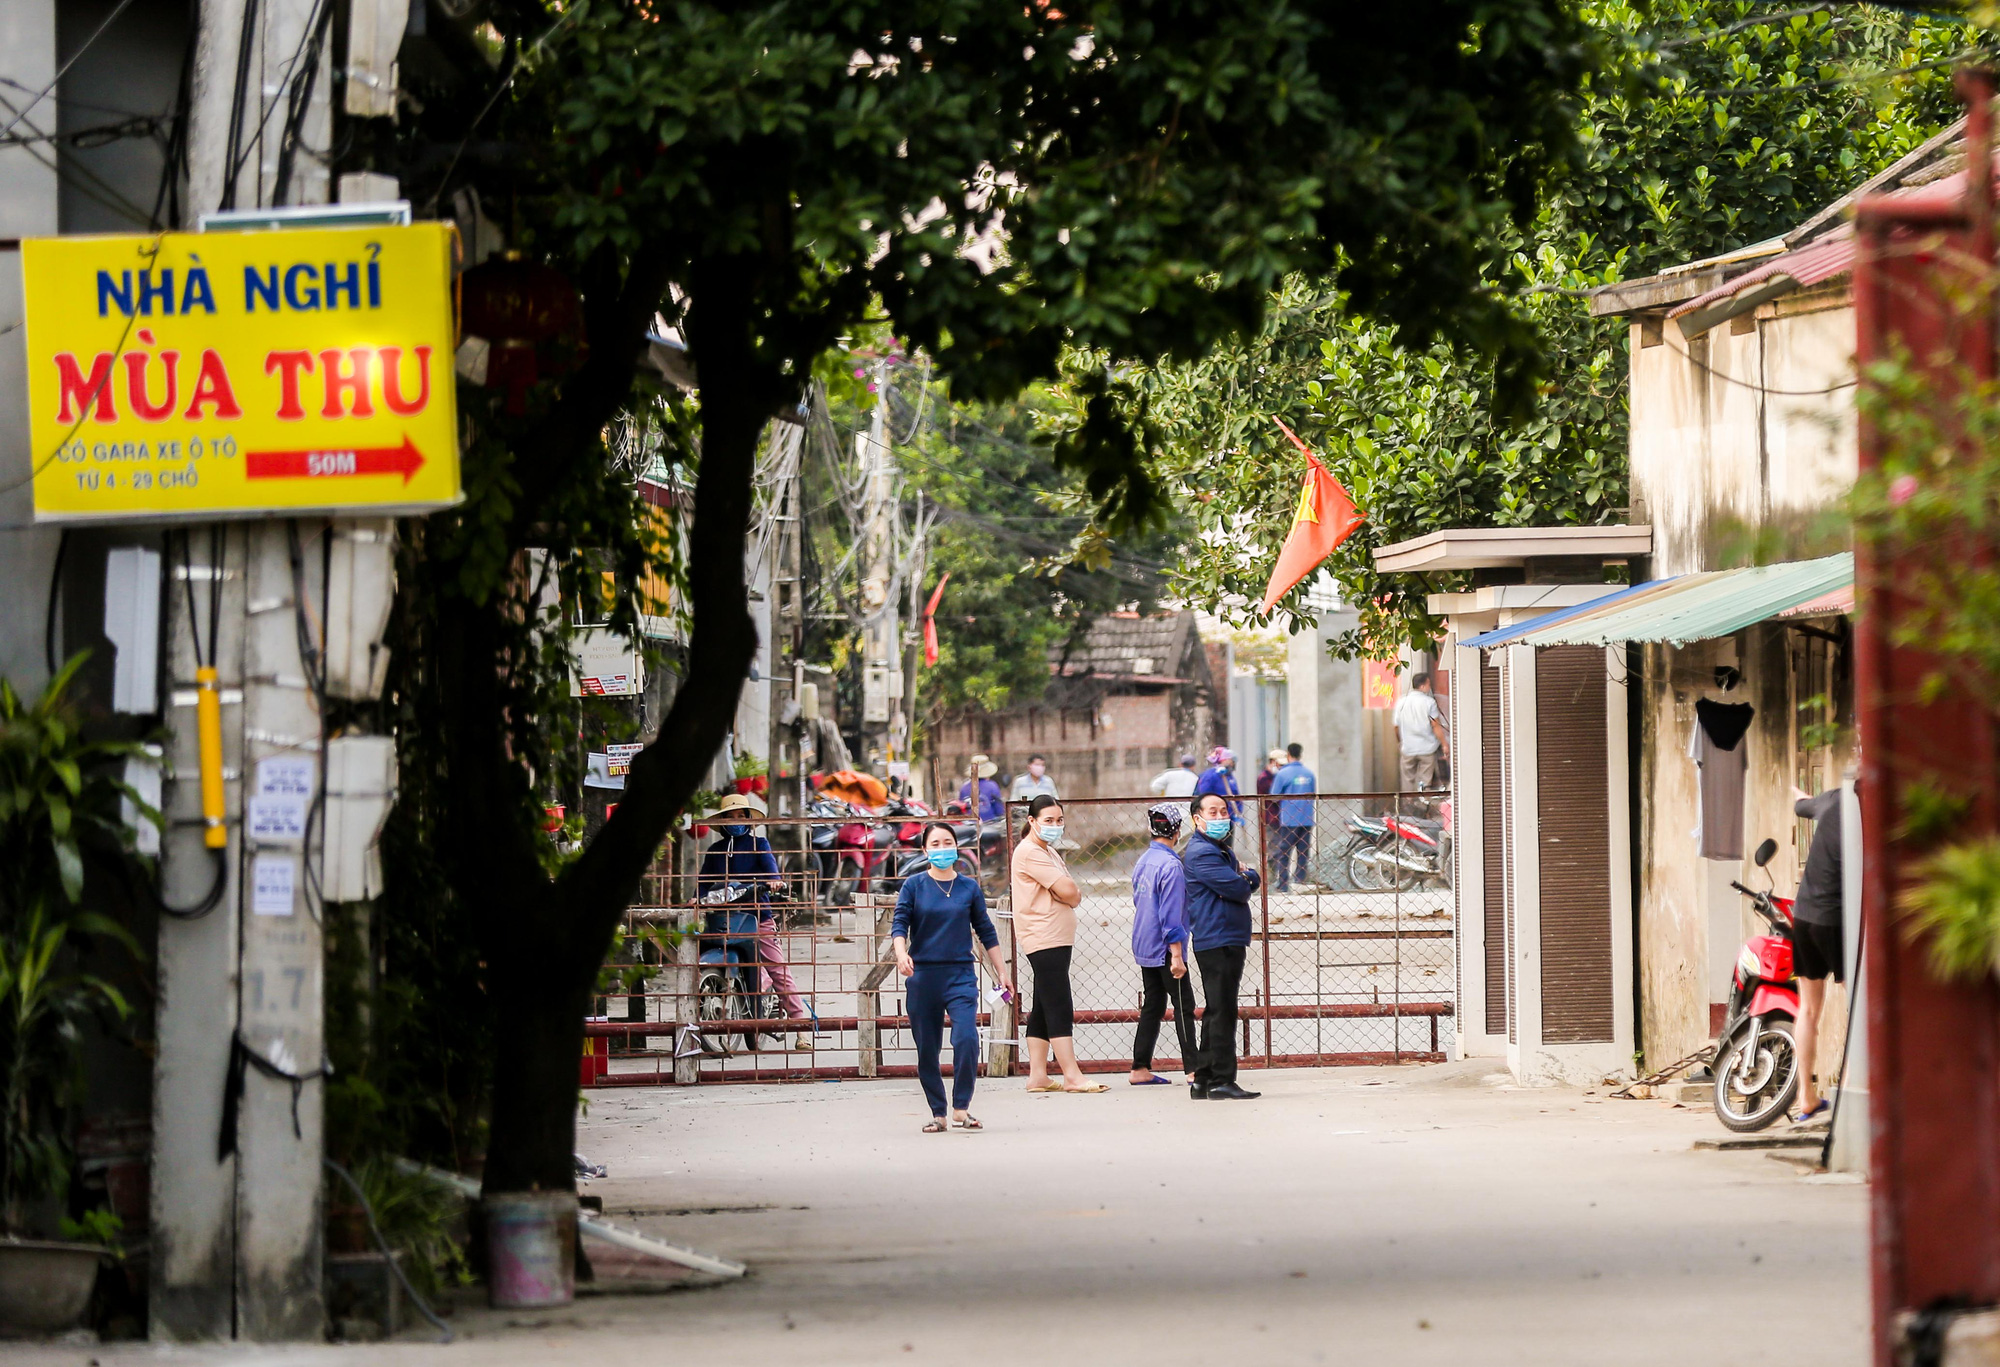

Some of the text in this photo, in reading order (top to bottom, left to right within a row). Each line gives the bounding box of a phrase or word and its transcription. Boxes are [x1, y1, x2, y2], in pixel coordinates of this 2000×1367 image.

[97, 241, 382, 317] NHÀ NGHỈ
[53, 328, 434, 426] MÙA THU
[57, 434, 238, 463] CÓ GARA XE Ô TÔ
[308, 452, 357, 475] 50M
[105, 471, 116, 490] 4
[133, 470, 153, 490] 29
